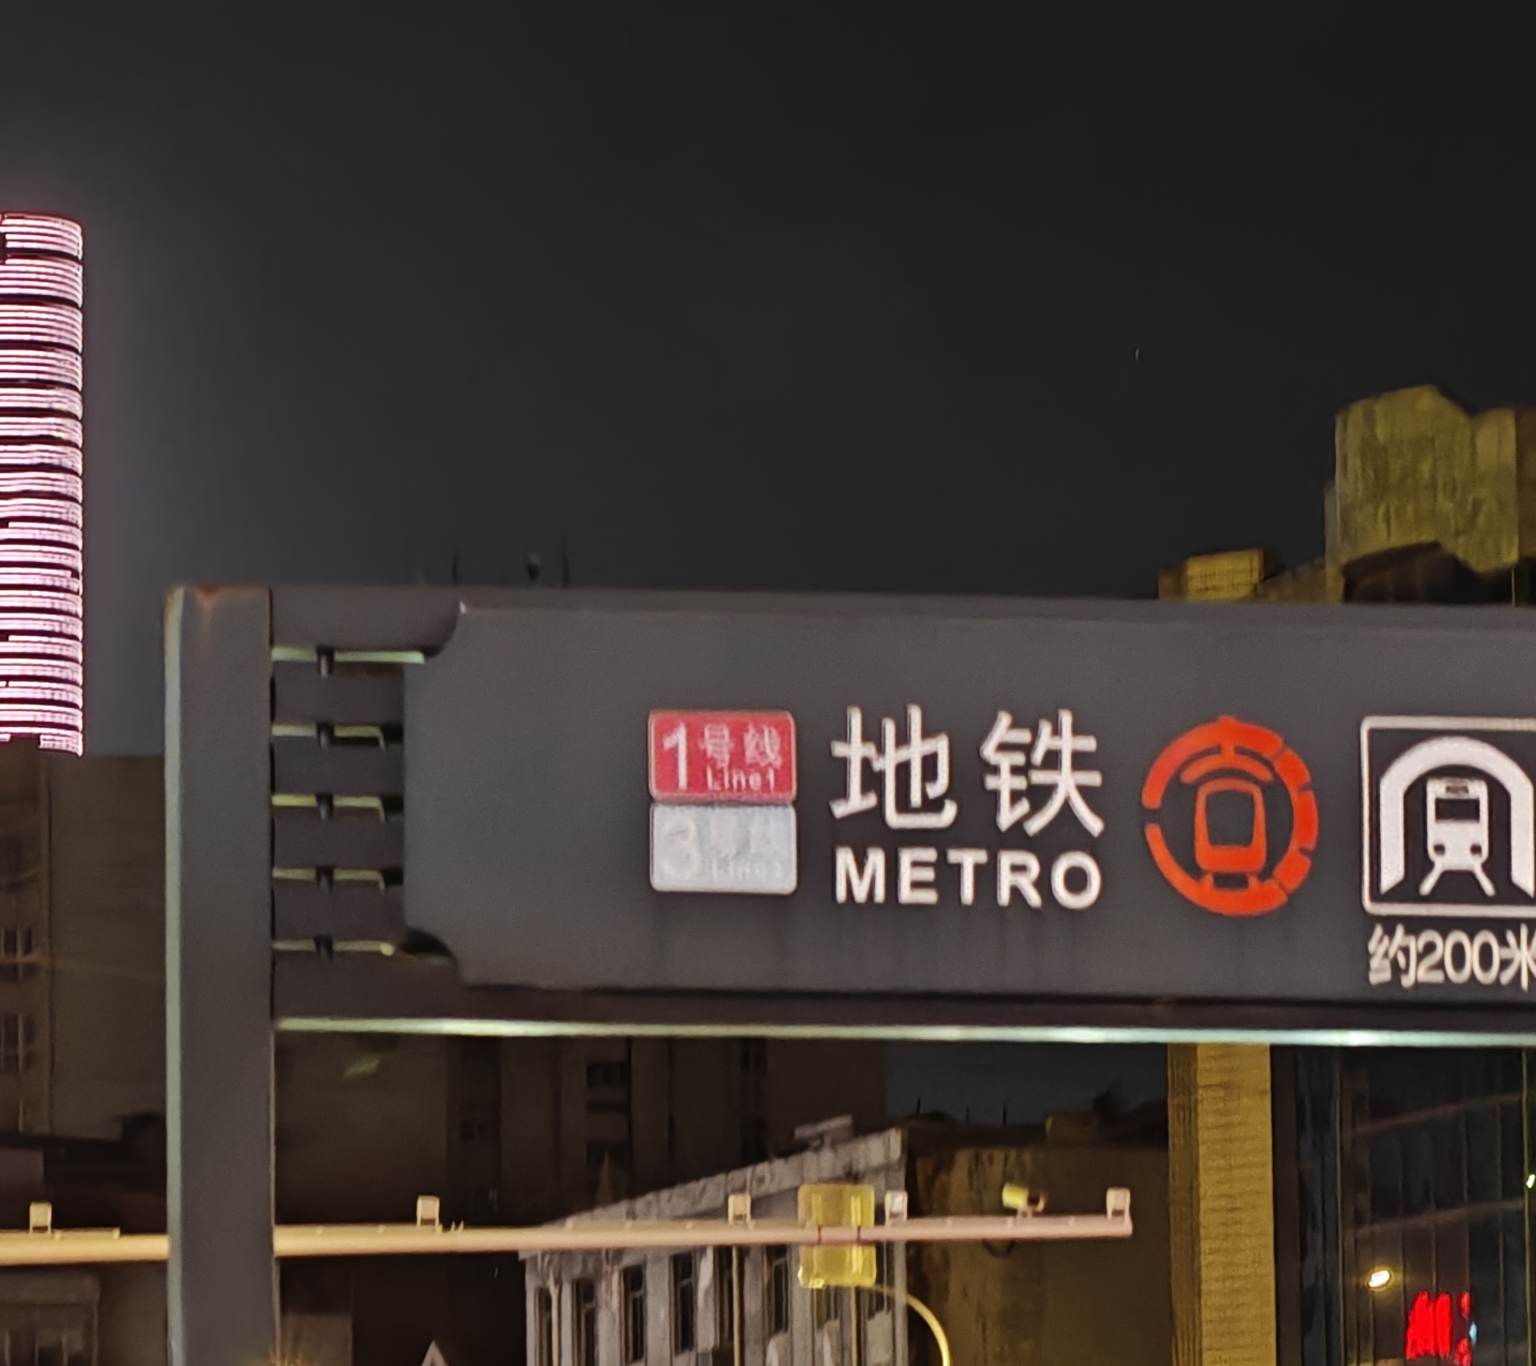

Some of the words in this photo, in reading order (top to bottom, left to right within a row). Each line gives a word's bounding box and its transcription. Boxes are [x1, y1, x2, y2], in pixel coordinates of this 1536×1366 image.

[662, 721, 782, 793] 1号线
[829, 703, 1106, 838] 地铁
[834, 846, 1103, 910] METRO
[1367, 922, 1536, 992] 约200米
